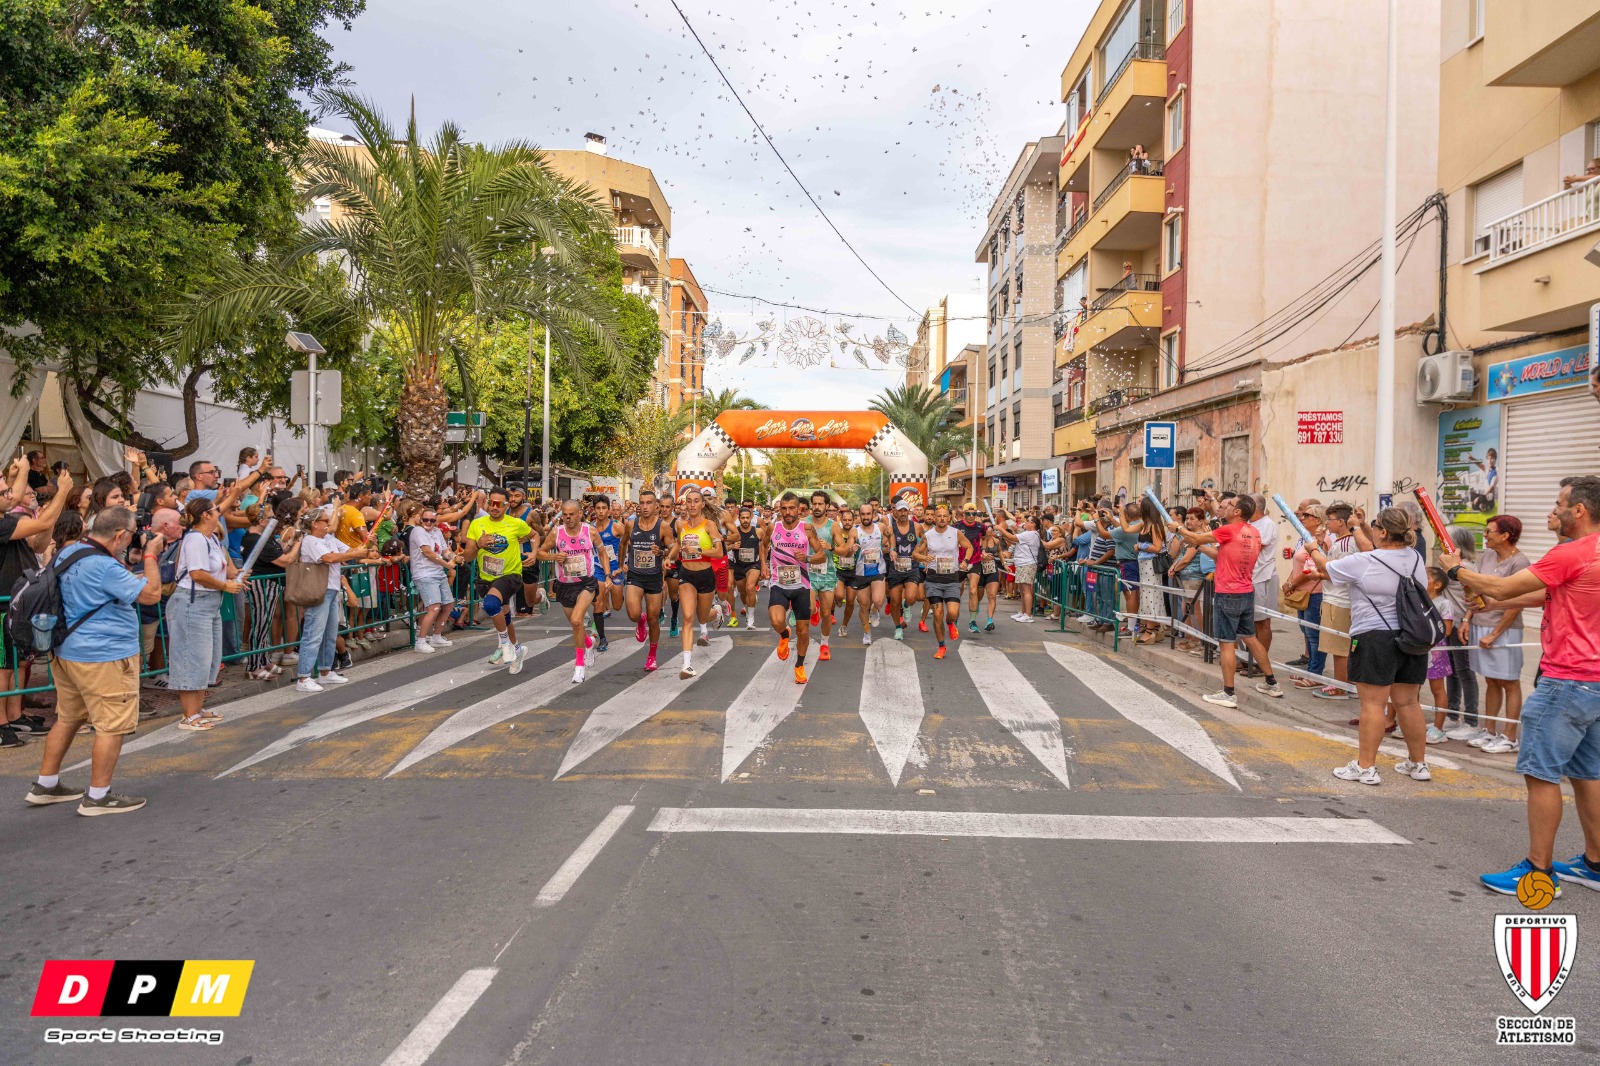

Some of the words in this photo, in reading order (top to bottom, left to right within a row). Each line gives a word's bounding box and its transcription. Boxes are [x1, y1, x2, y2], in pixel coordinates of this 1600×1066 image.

[1521, 358, 1562, 381] WORLD
[1562, 358, 1575, 374] of
[1298, 411, 1343, 422] PRÉSTAMOS
[1315, 422, 1343, 431] COCHE
[1298, 431, 1311, 443] 691
[1314, 431, 1327, 443] 787
[783, 571, 796, 579] 98
